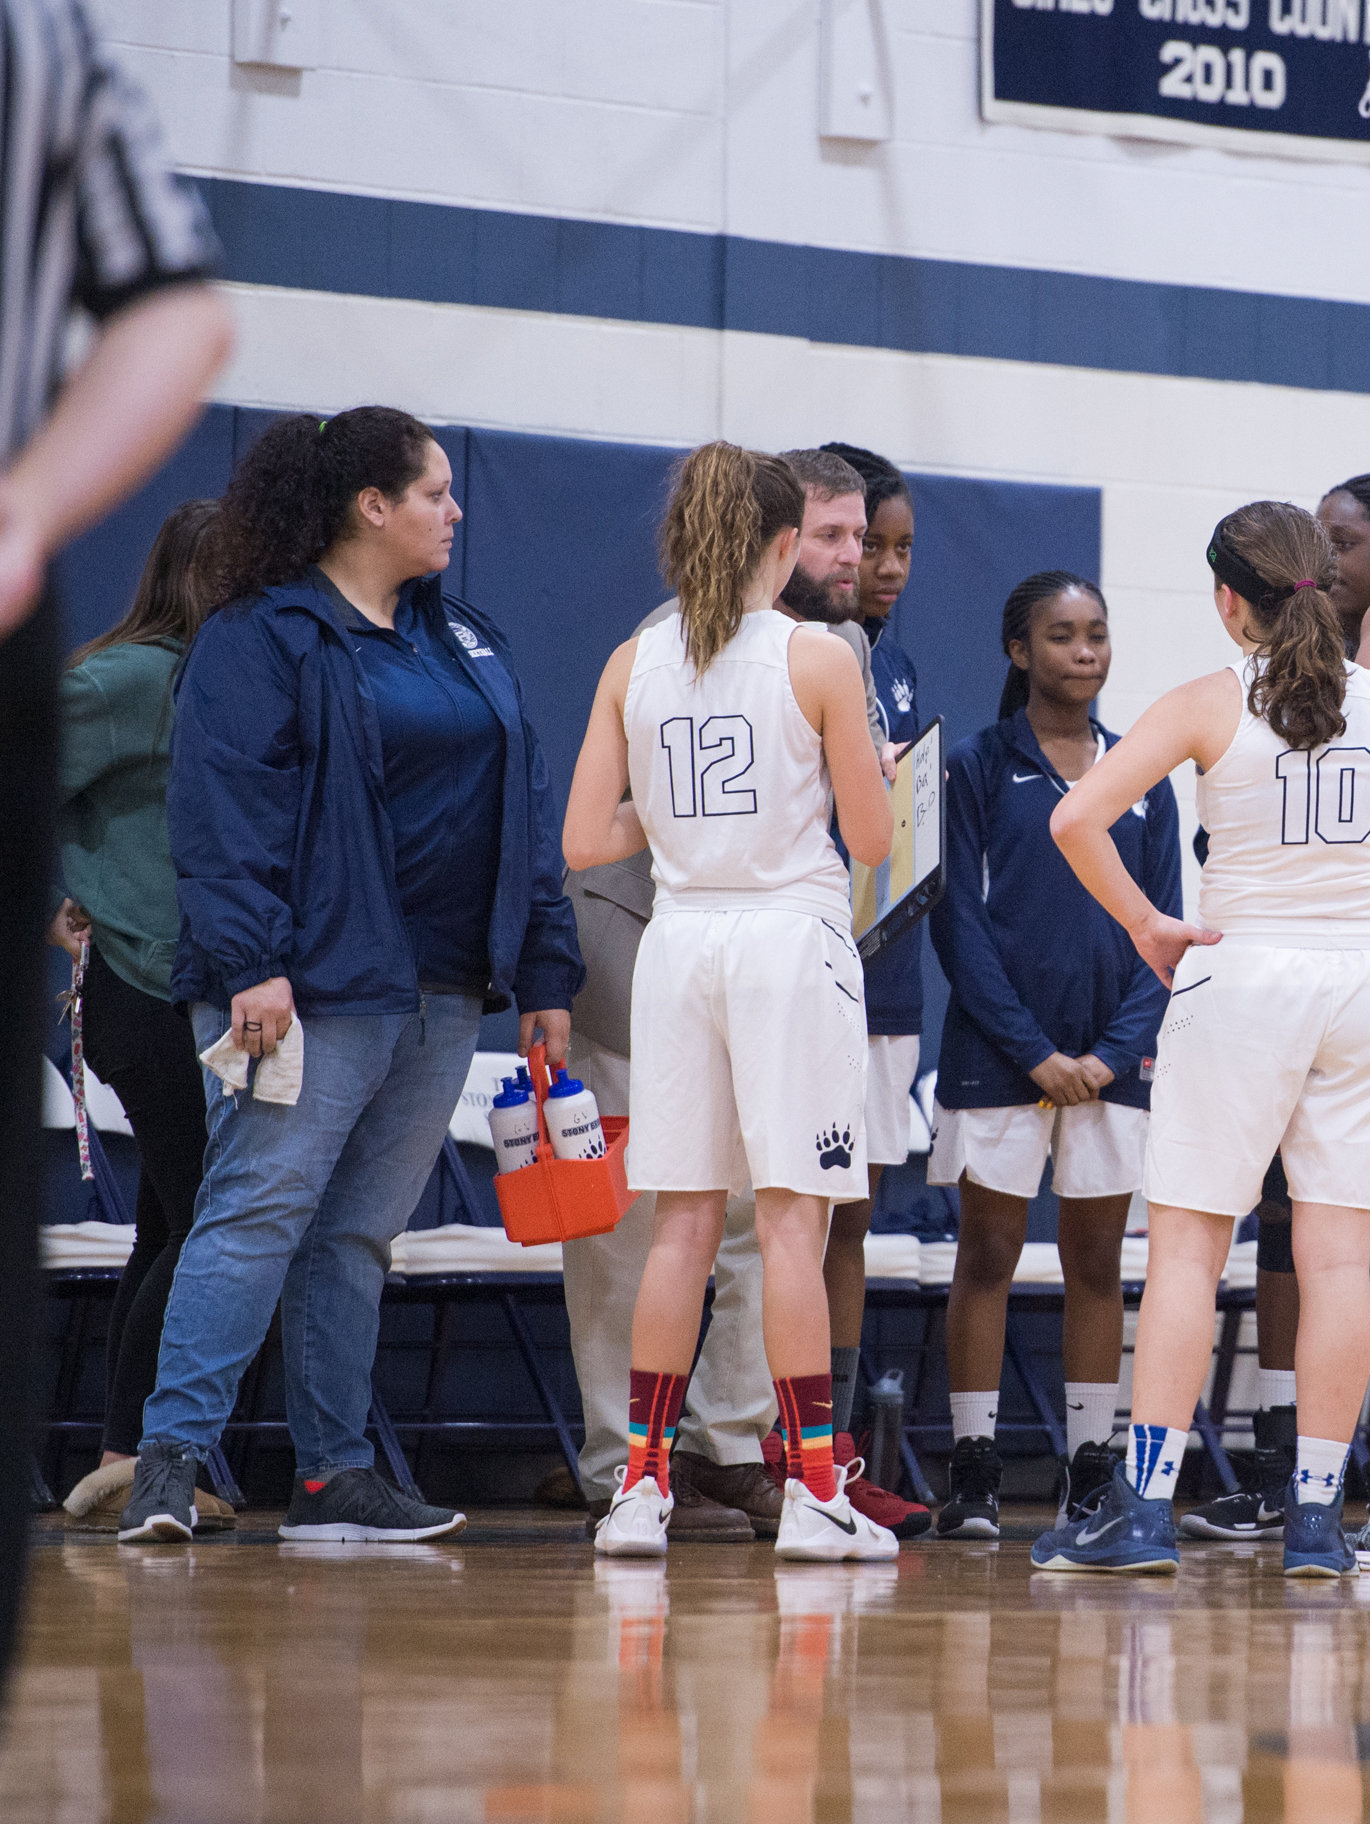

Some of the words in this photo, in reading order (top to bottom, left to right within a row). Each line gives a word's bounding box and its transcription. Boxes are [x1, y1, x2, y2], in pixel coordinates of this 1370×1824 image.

[1159, 40, 1286, 109] 2010
[660, 714, 757, 818] 12
[503, 1133, 532, 1148] STONY
[562, 1122, 590, 1138] STONY
